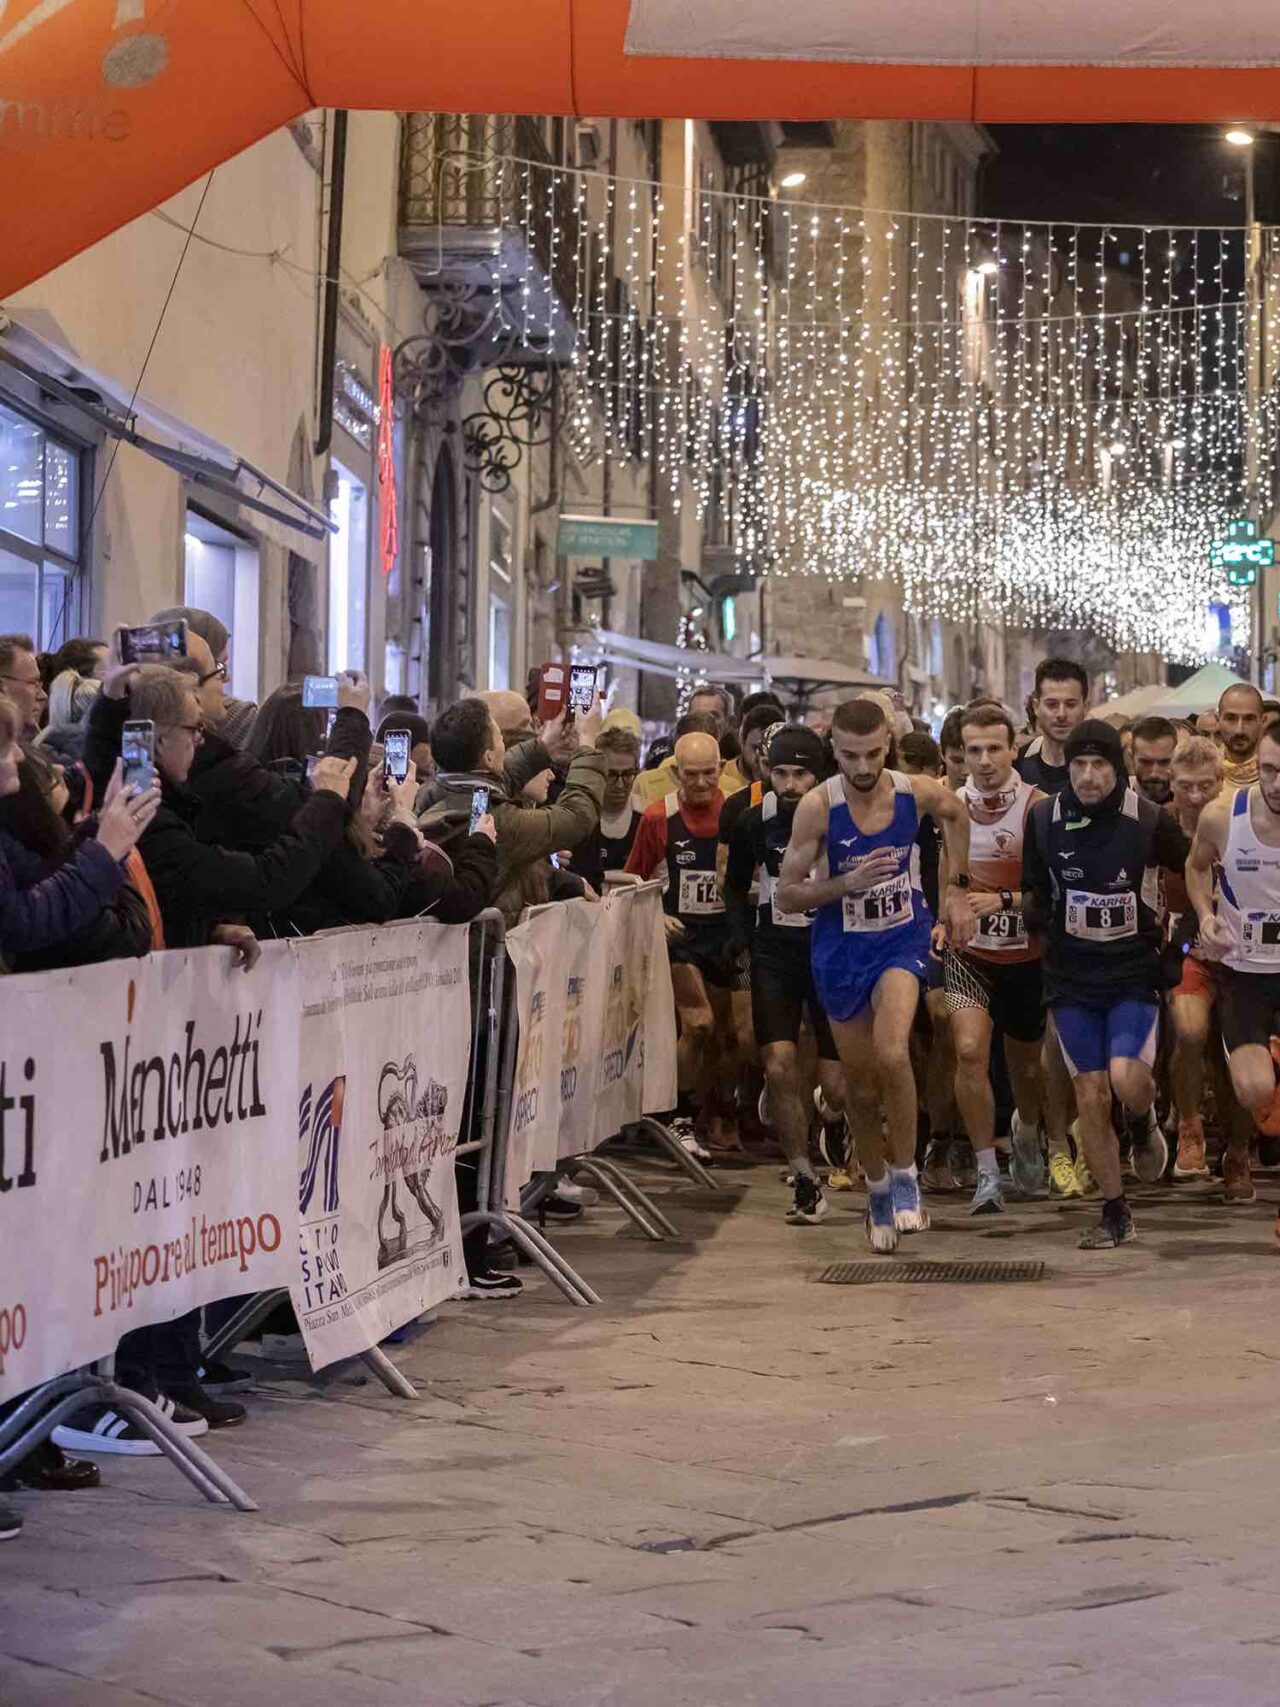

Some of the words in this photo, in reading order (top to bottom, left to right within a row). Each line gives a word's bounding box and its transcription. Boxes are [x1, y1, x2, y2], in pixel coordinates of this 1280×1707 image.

[869, 876, 906, 898] KARHU
[873, 893, 896, 917] 15
[1090, 896, 1133, 907] KARHU
[987, 913, 1011, 938] 29
[1100, 907, 1113, 929] 8
[100, 980, 267, 1164] Menchetti
[133, 1181, 171, 1214] DAL
[200, 1213, 282, 1273] tempo
